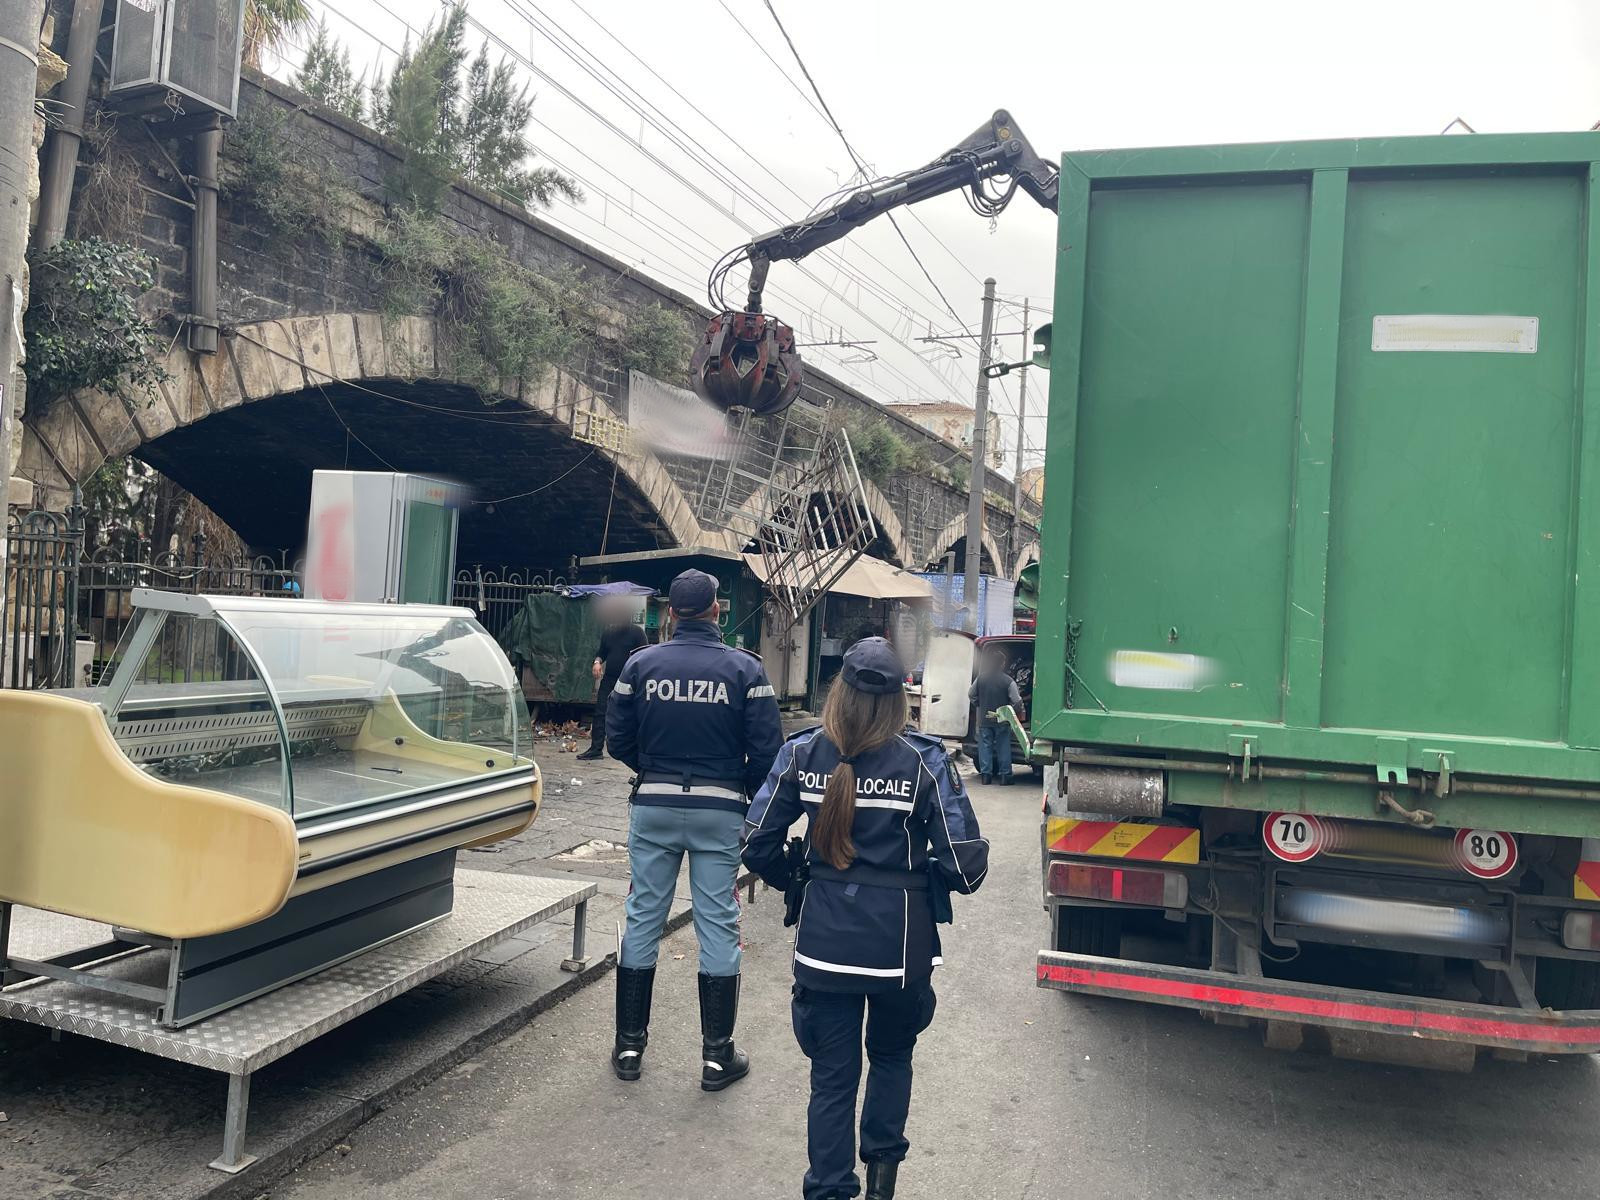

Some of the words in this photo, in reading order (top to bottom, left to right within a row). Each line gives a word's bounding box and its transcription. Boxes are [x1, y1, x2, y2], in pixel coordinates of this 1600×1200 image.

[645, 679, 730, 705] POLIZIA
[798, 771, 835, 790] POLI
[856, 777, 912, 797] LOCALE
[1280, 820, 1307, 843] 70
[1470, 835, 1501, 858] 80
